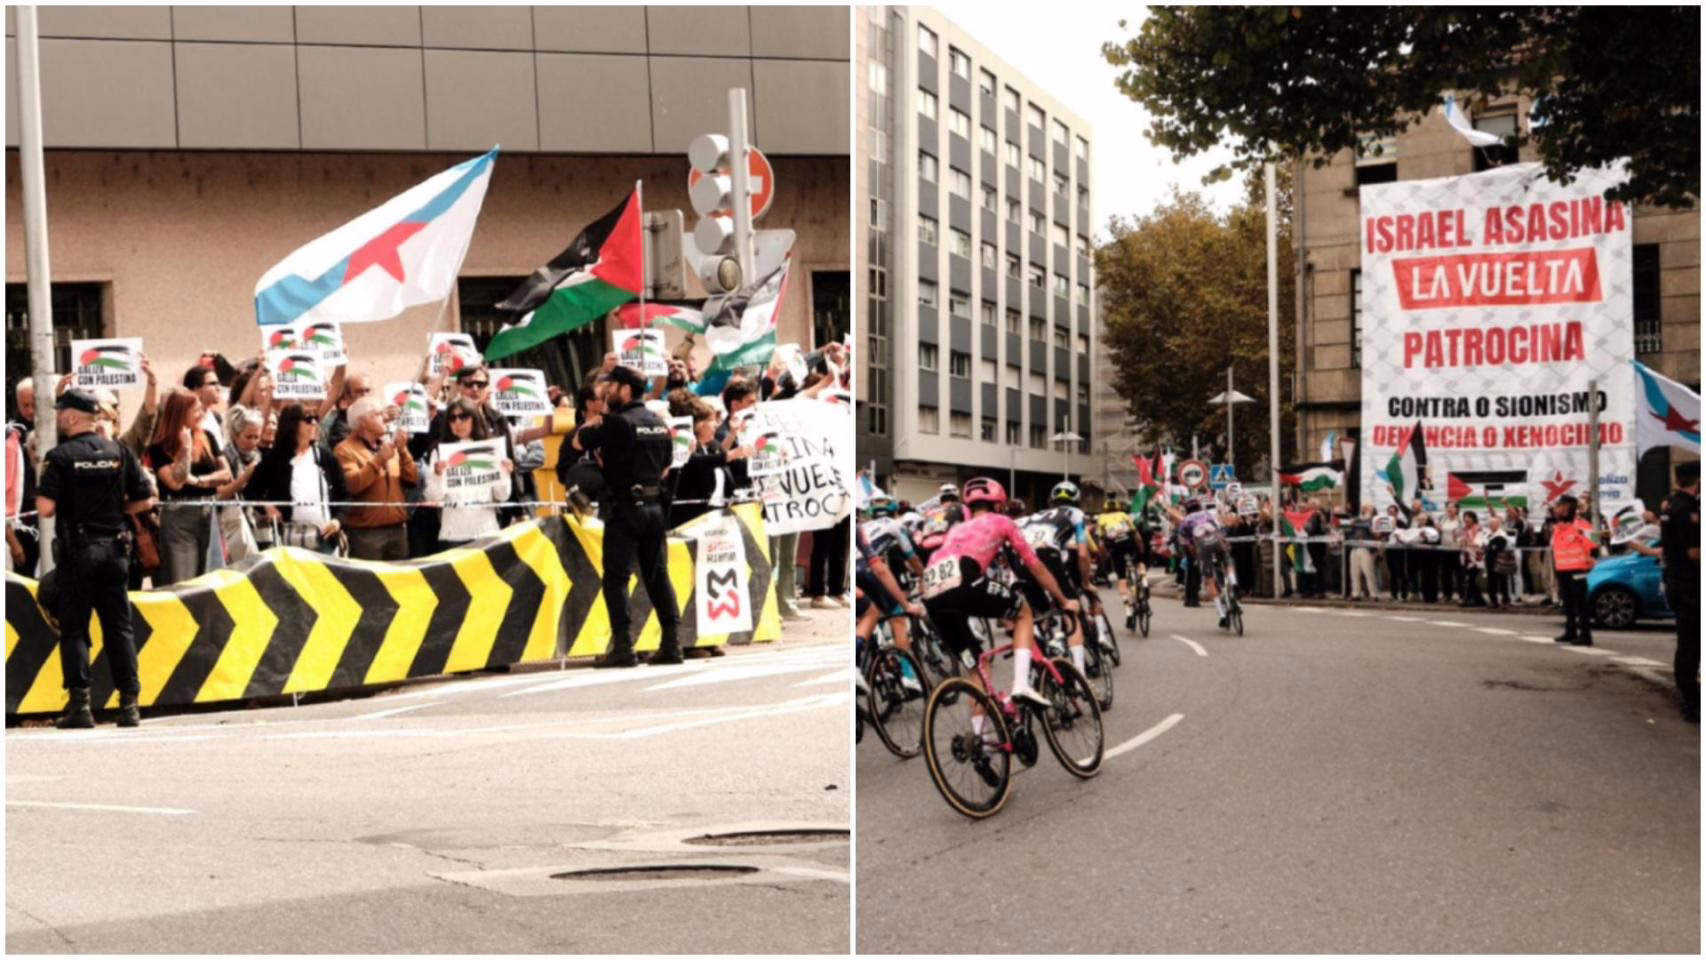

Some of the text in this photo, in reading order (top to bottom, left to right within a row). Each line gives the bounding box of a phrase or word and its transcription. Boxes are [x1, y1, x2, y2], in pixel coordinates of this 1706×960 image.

[1366, 195, 1625, 254] ISRAEL ASASINA
[1412, 258, 1585, 300] LA VUELTA
[1404, 320, 1586, 369] PATROCINA
[96, 373, 137, 385] PALESTINA
[1388, 390, 1608, 418] CONTRA O SIONISMO
[1373, 425, 1478, 448] DENNCIA
[1482, 426, 1497, 448] O
